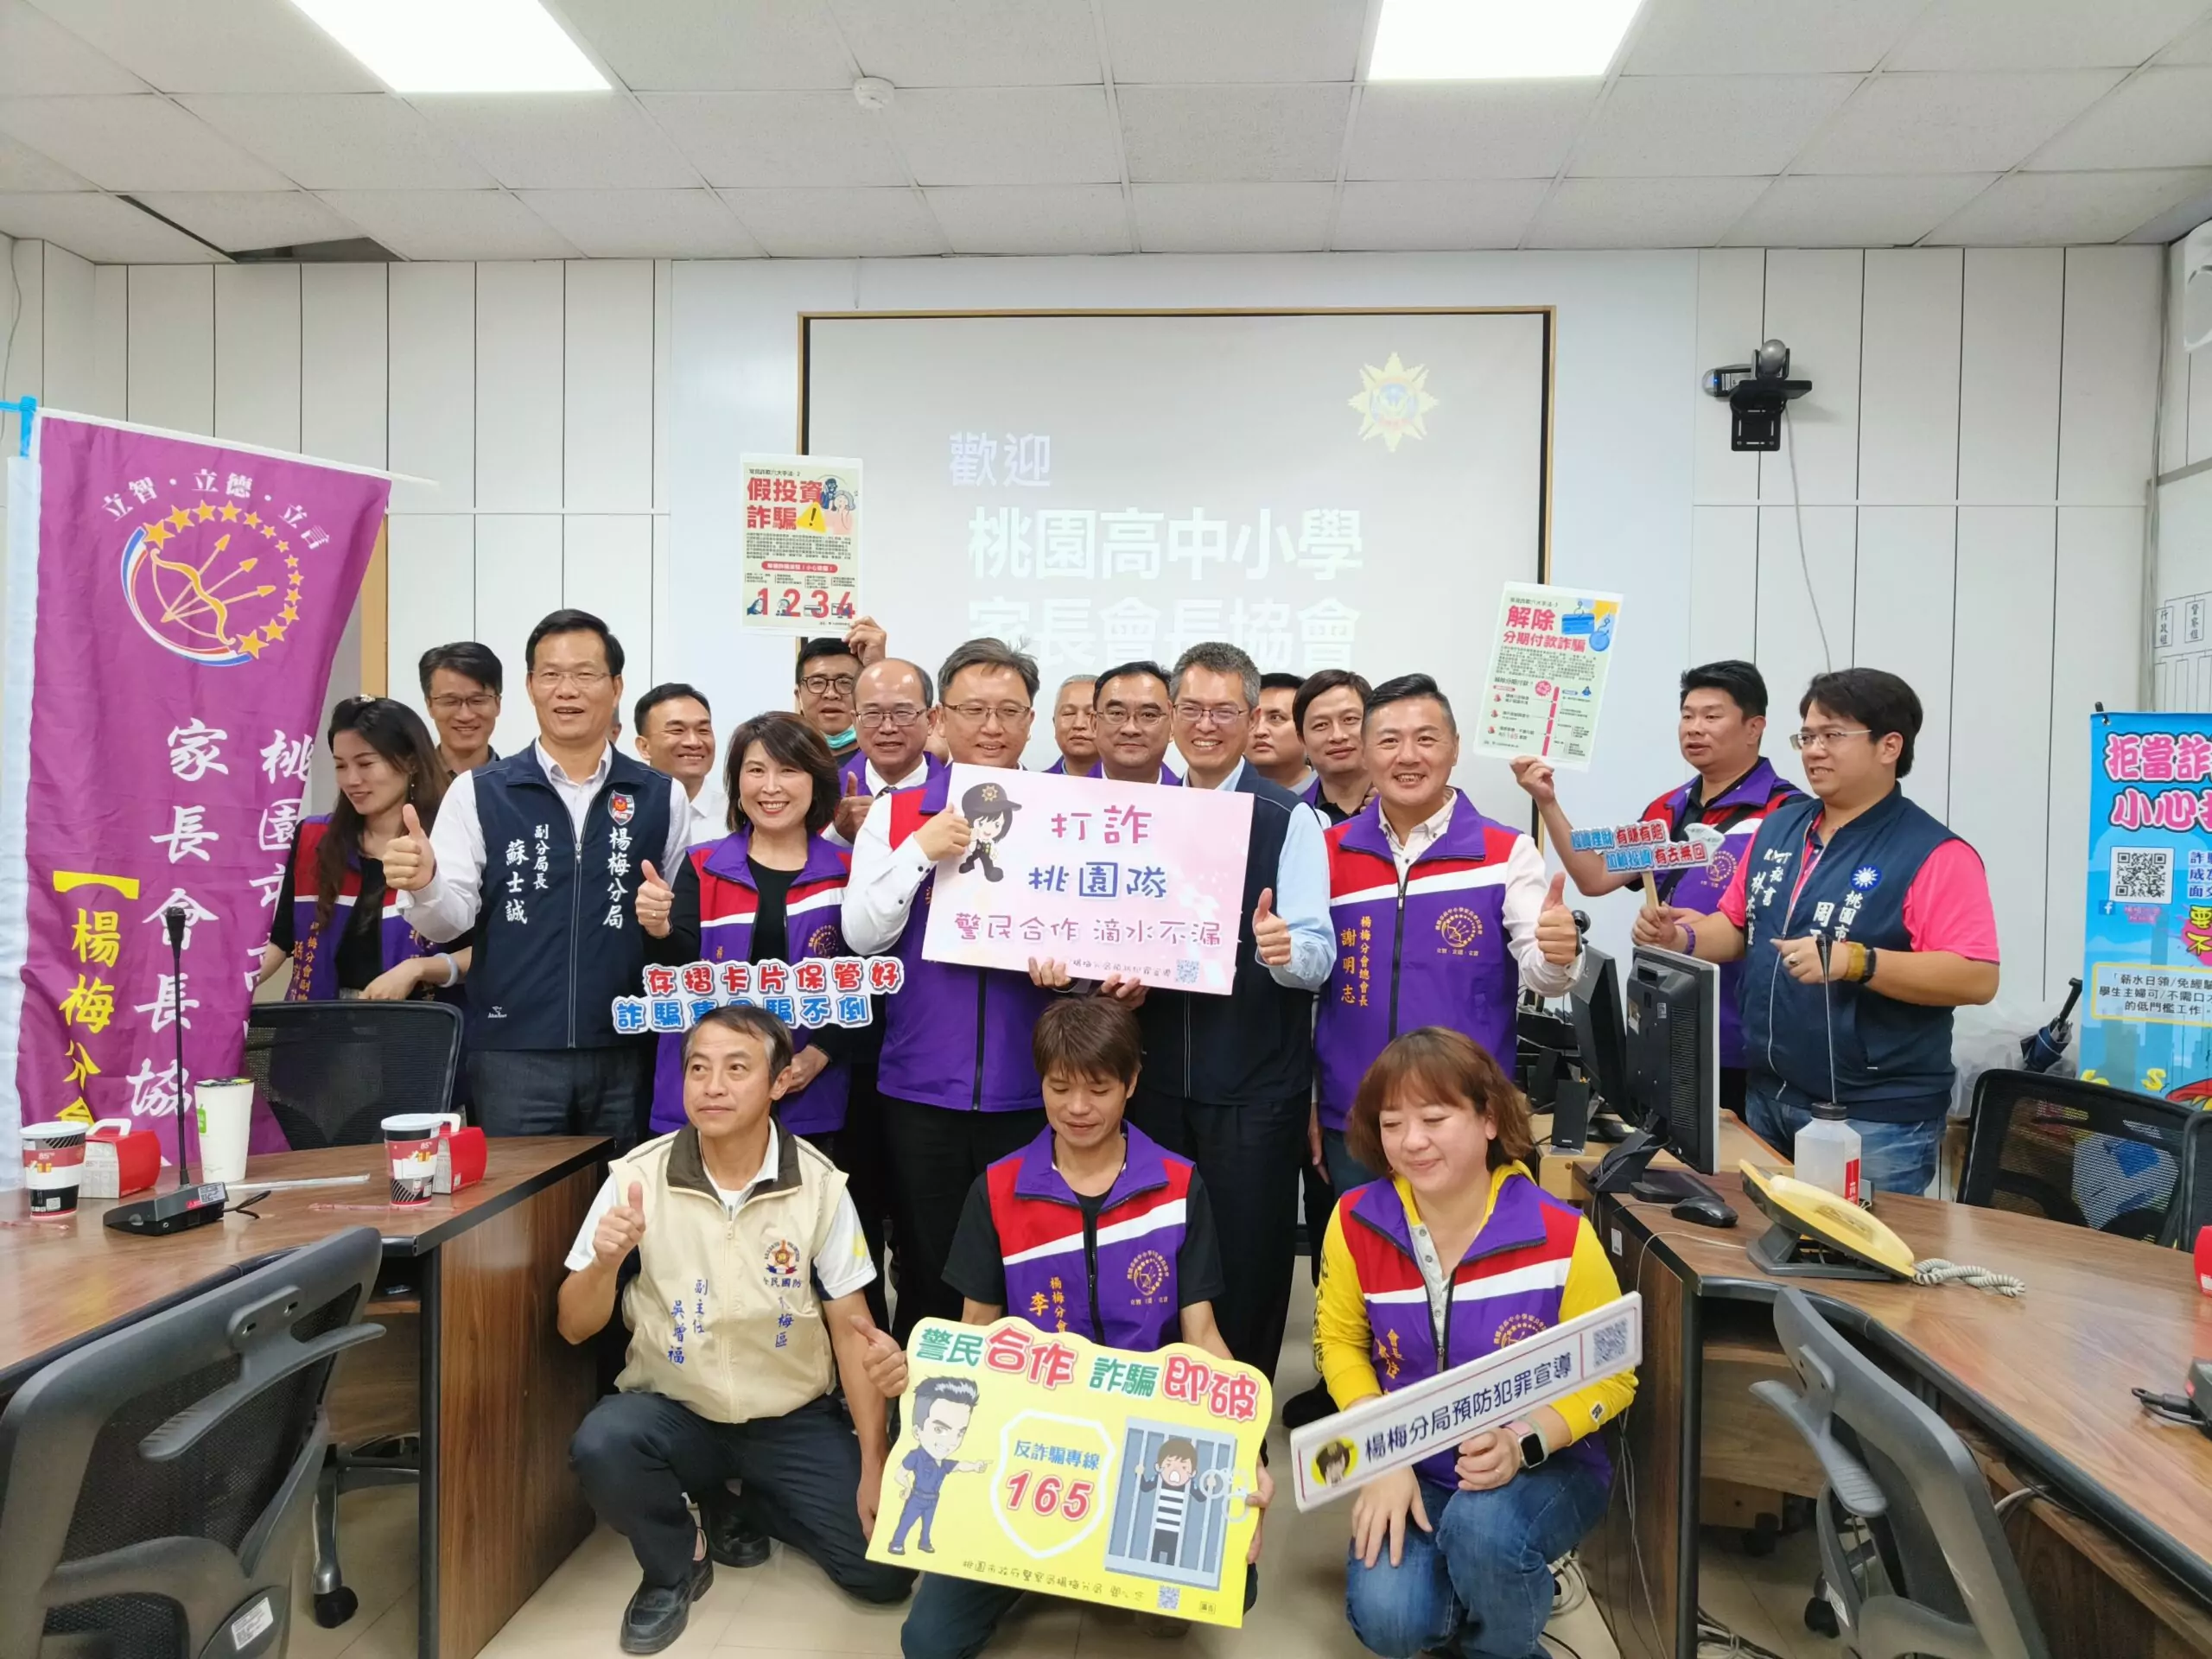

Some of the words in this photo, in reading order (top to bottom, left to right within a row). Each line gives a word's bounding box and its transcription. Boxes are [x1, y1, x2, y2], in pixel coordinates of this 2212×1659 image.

[949, 432, 1051, 487] 歡迎
[747, 477, 823, 504] 假投資
[747, 505, 797, 530] 詐騙
[967, 505, 1363, 581] 桃園高中小學
[1503, 631, 1586, 652] 分期付款詐騙
[1505, 605, 1556, 631] 解除
[1052, 804, 1152, 844] 打詐
[1616, 823, 1665, 847] 有賺有賠
[532, 823, 550, 889] 副分局長
[602, 826, 633, 929] 楊梅分局
[1028, 861, 1167, 898] 桃園隊
[1655, 842, 1707, 867] 有去無回
[505, 839, 530, 925] 蘇士誠
[127, 717, 230, 1165] 家長會長協
[954, 912, 1079, 940] 警民合作
[1093, 918, 1222, 946] 滴水不漏
[1809, 901, 1835, 937] 周
[1834, 890, 1864, 943] 桃園市
[647, 961, 899, 995] 存摺卡片保管好
[1341, 928, 1357, 1004] 謝明志
[1358, 916, 1372, 1007] 楊梅分會總會長
[616, 996, 868, 1028] 詐騙集騙不倒
[692, 1279, 709, 1334] 副主任
[1029, 1292, 1049, 1316] 李
[1050, 1276, 1068, 1332] 楊梅分會
[668, 1300, 687, 1364] 吳增福
[915, 1325, 1075, 1387] 警民合作
[1090, 1356, 1258, 1421] 詐騙即破
[1364, 1352, 1573, 1463] 楊梅分局預防犯罪宣導
[1014, 1440, 1100, 1471] 反詐騙專線
[1006, 1471, 1094, 1521] 165
